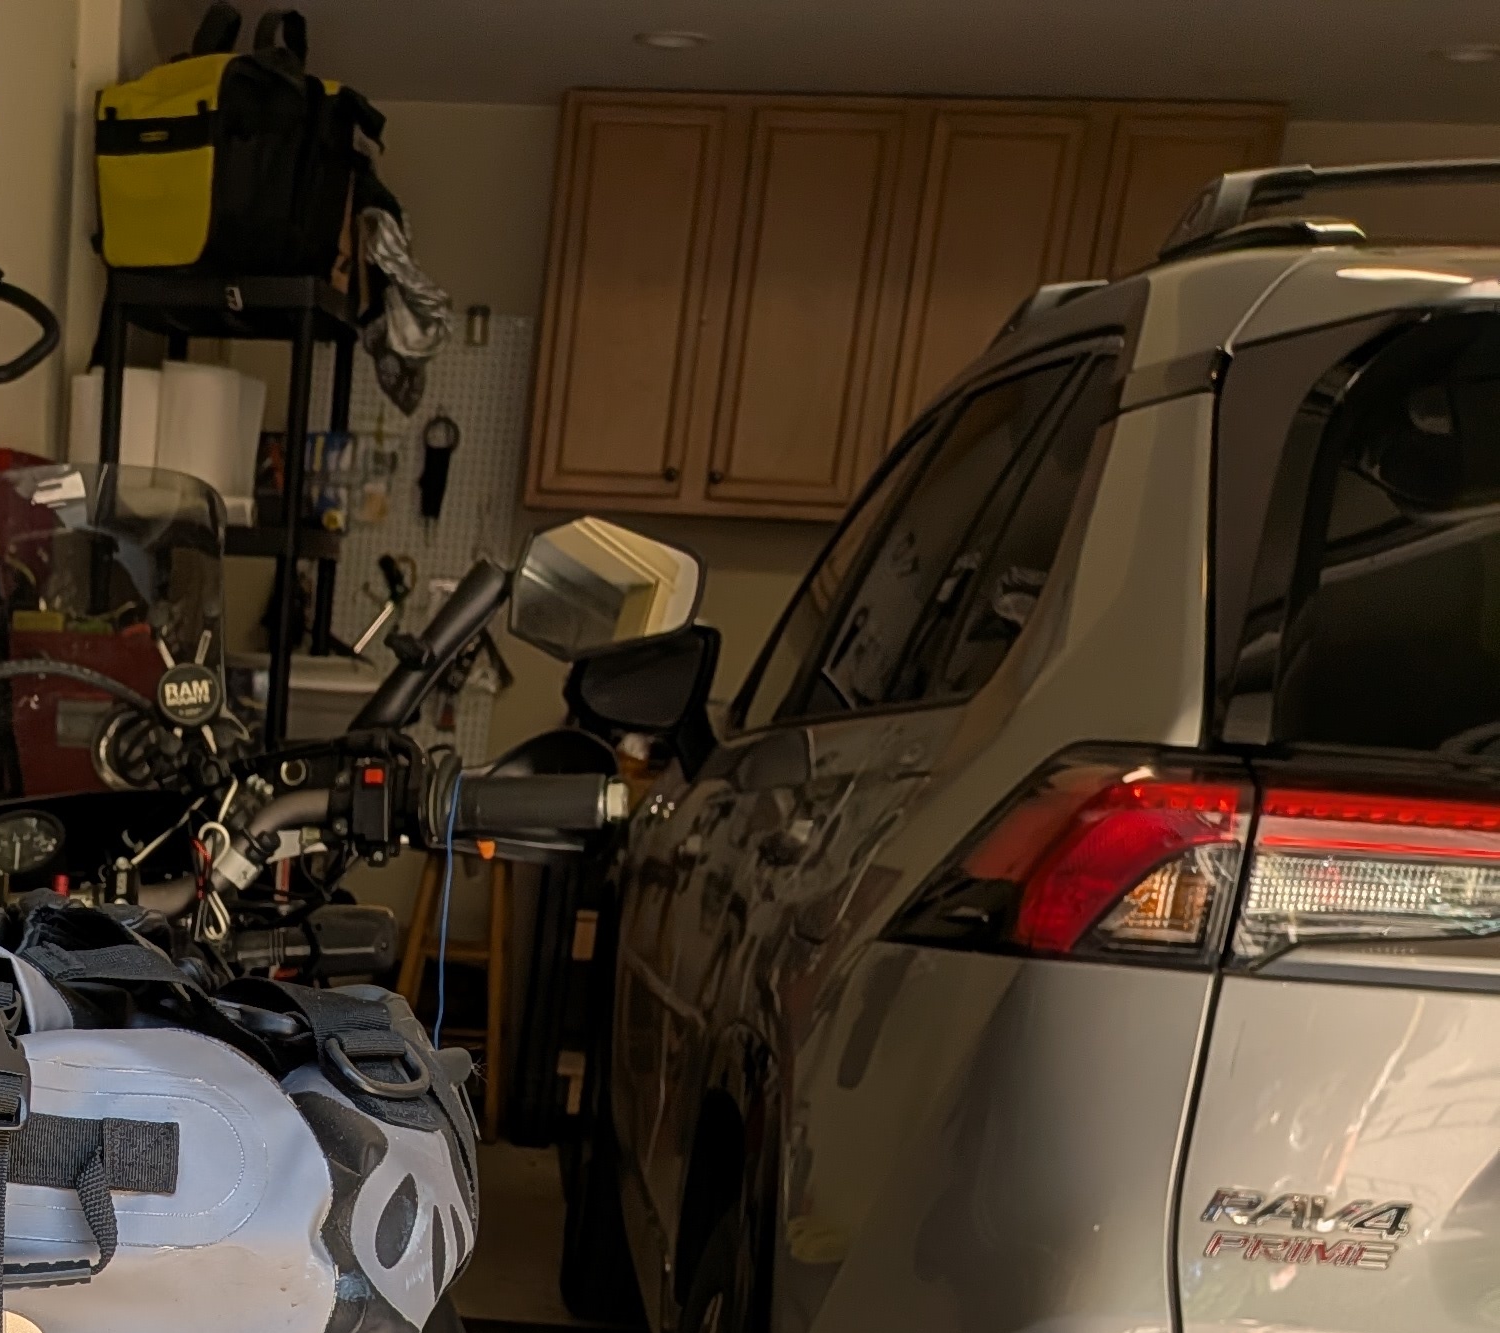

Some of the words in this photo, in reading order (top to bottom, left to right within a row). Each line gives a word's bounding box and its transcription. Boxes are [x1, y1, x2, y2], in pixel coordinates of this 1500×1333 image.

[164, 679, 210, 699] RAM
[1201, 1187, 1412, 1240] RAV4
[1203, 1230, 1399, 1270] PRIME
